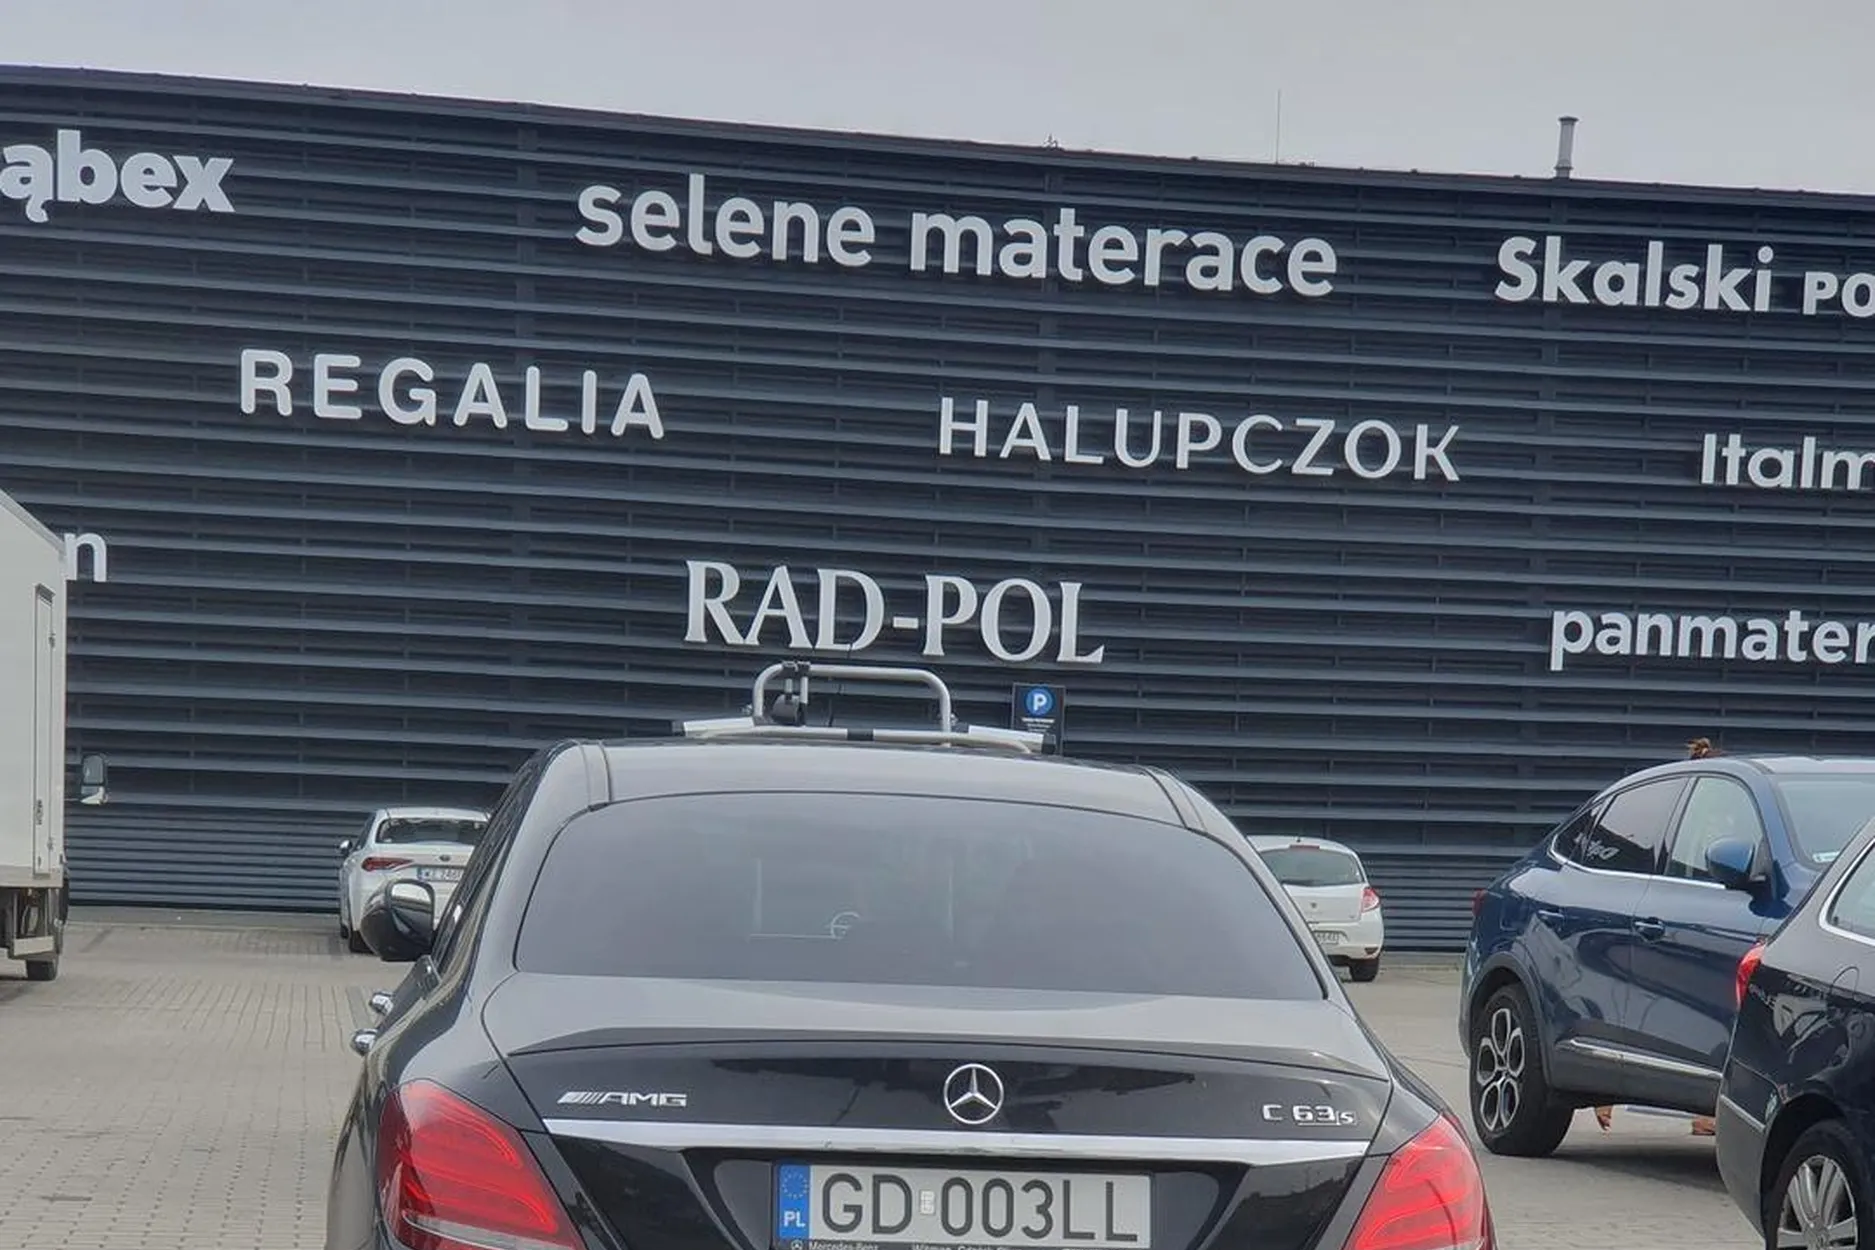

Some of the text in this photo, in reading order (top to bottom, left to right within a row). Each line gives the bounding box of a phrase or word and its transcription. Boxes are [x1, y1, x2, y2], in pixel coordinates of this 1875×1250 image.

[0, 130, 235, 223] ąbex
[575, 173, 1337, 296] selene materace
[1495, 235, 1774, 312] Skalski
[240, 348, 664, 439] REGALIA
[938, 396, 1460, 481] HALUPCZOK
[684, 560, 1105, 664] RAD-POL
[598, 1091, 688, 1107] AMG
[1262, 1104, 1283, 1120] C
[784, 1211, 805, 1228] PL
[821, 1172, 1139, 1243] GD 003LL
